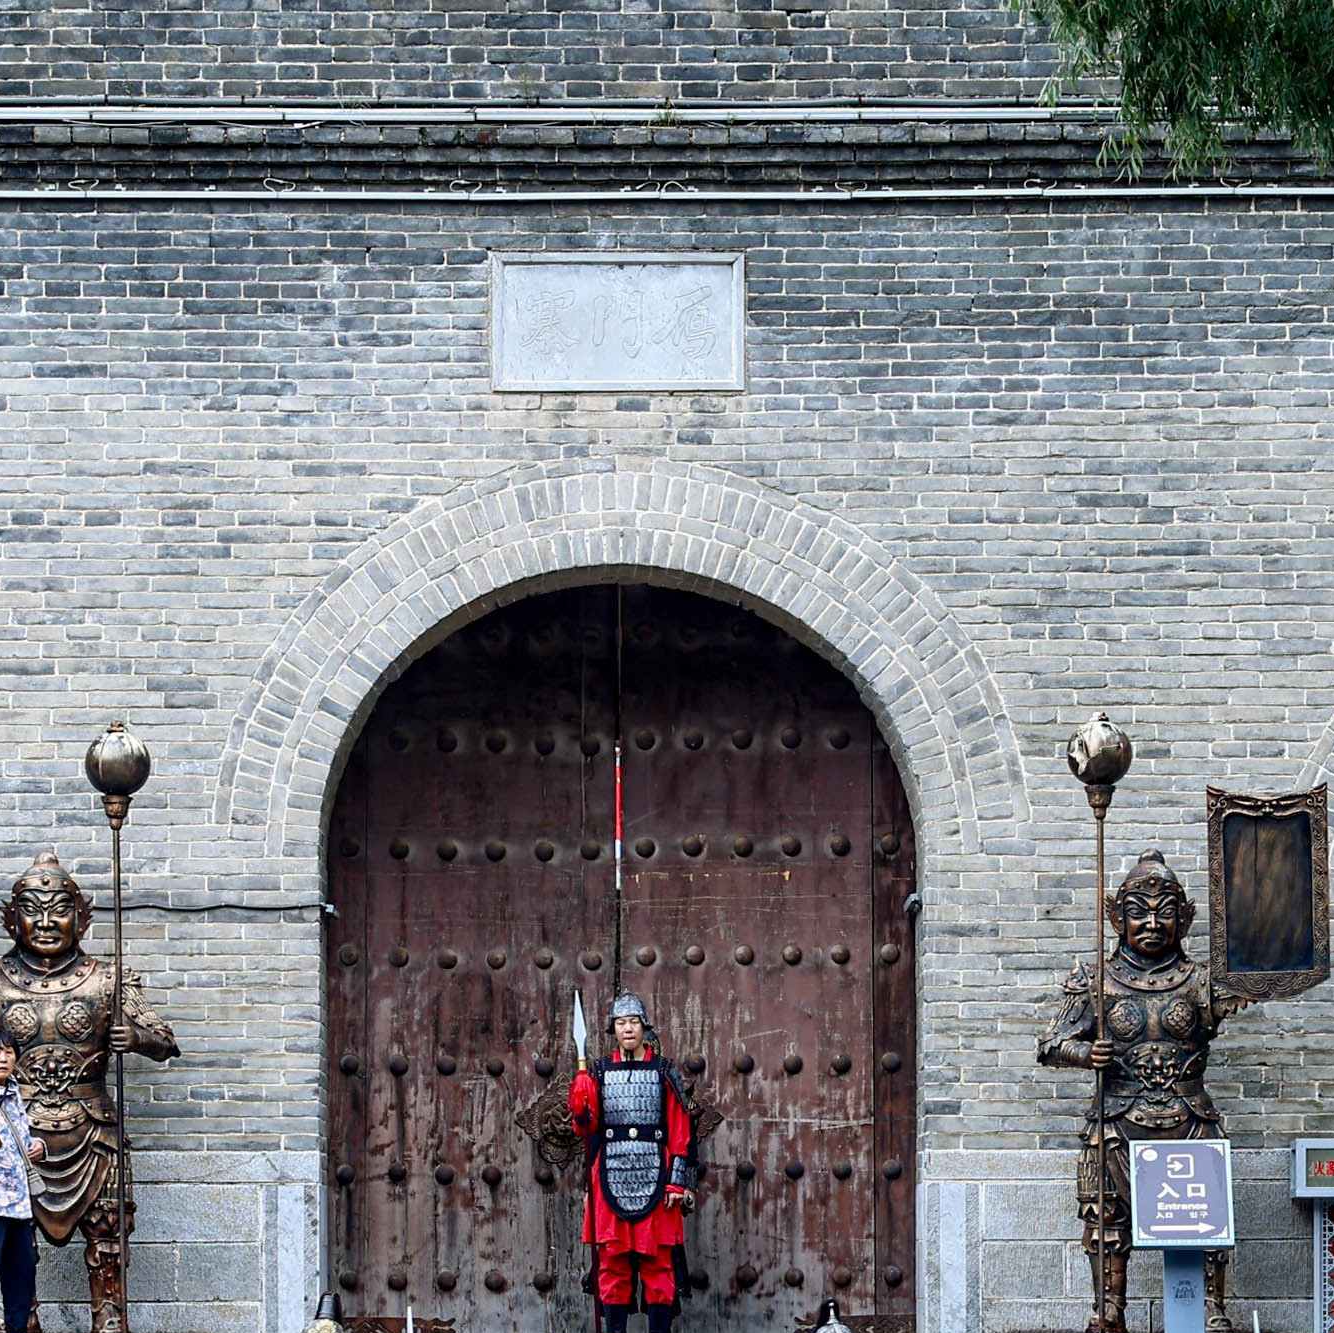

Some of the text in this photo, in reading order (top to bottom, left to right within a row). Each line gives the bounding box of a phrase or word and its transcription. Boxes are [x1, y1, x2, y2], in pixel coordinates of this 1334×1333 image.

[1156, 1182, 1206, 1199] 入口
[1156, 1202, 1209, 1211] Entrance
[1155, 1211, 1174, 1220] 入口
[1188, 1211, 1209, 1220] 입구
